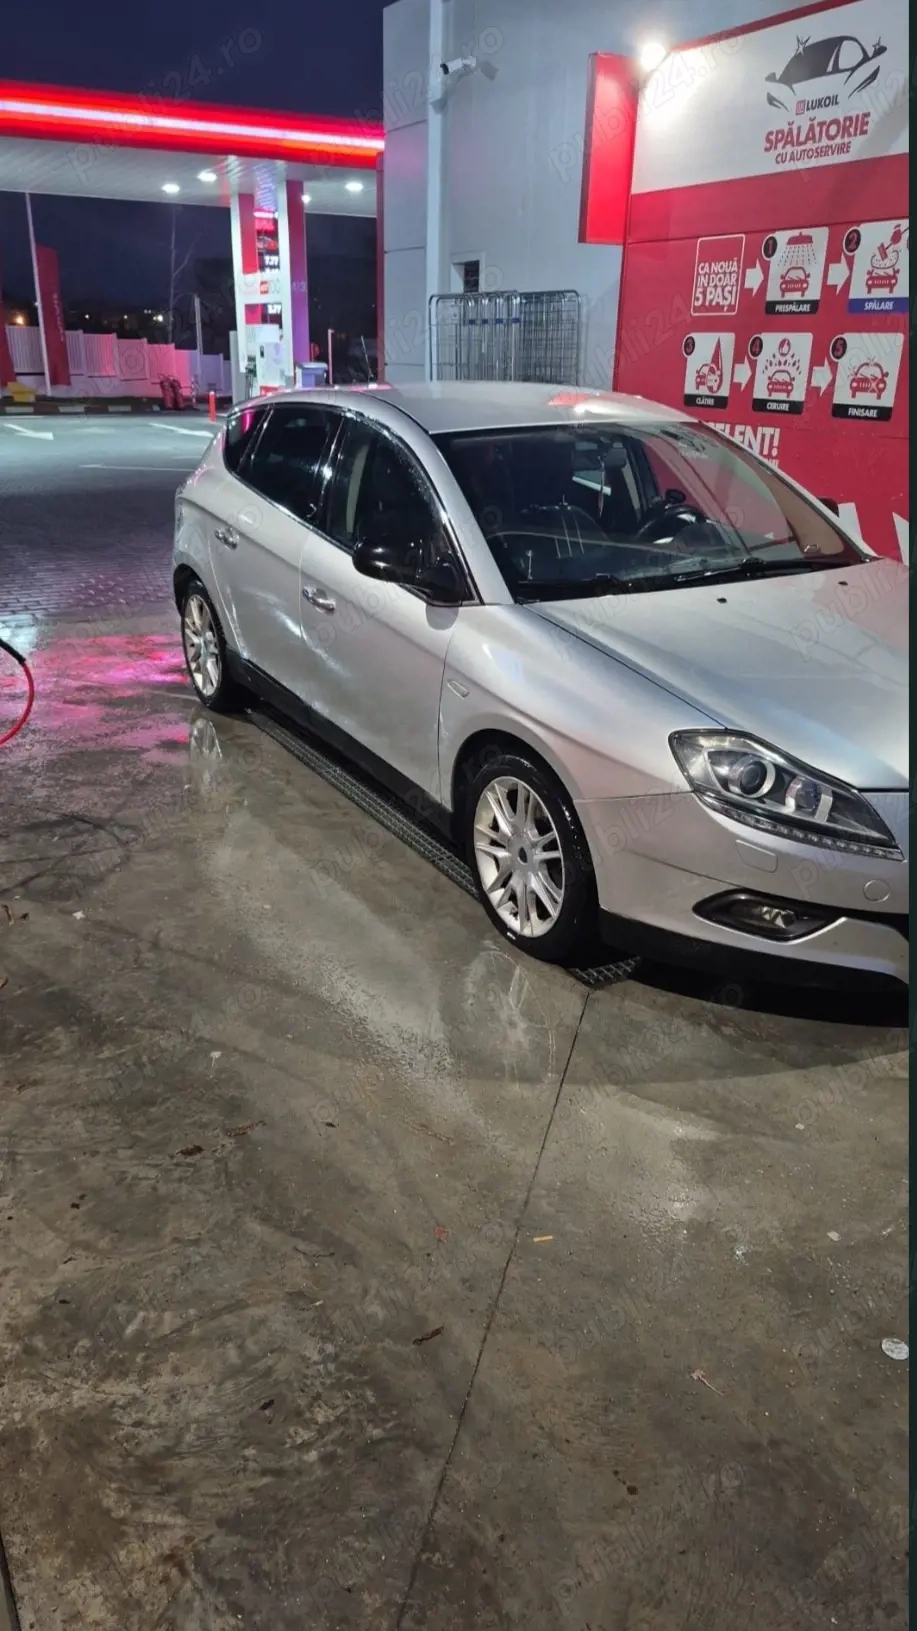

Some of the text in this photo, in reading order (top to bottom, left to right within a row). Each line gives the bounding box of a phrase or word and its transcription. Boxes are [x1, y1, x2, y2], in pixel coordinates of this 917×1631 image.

[806, 94, 839, 112] LUKOIL
[764, 112, 871, 152] SPĂLĂTORIE
[775, 141, 852, 164] CU AUTOSERVIRE
[848, 231, 858, 249] 2
[698, 257, 738, 274] CA NOUĂ
[698, 273, 737, 287] IN DOAR
[694, 289, 703, 306] 5
[864, 300, 894, 311] SPĂLARE
[848, 408, 878, 418] FINISARE
